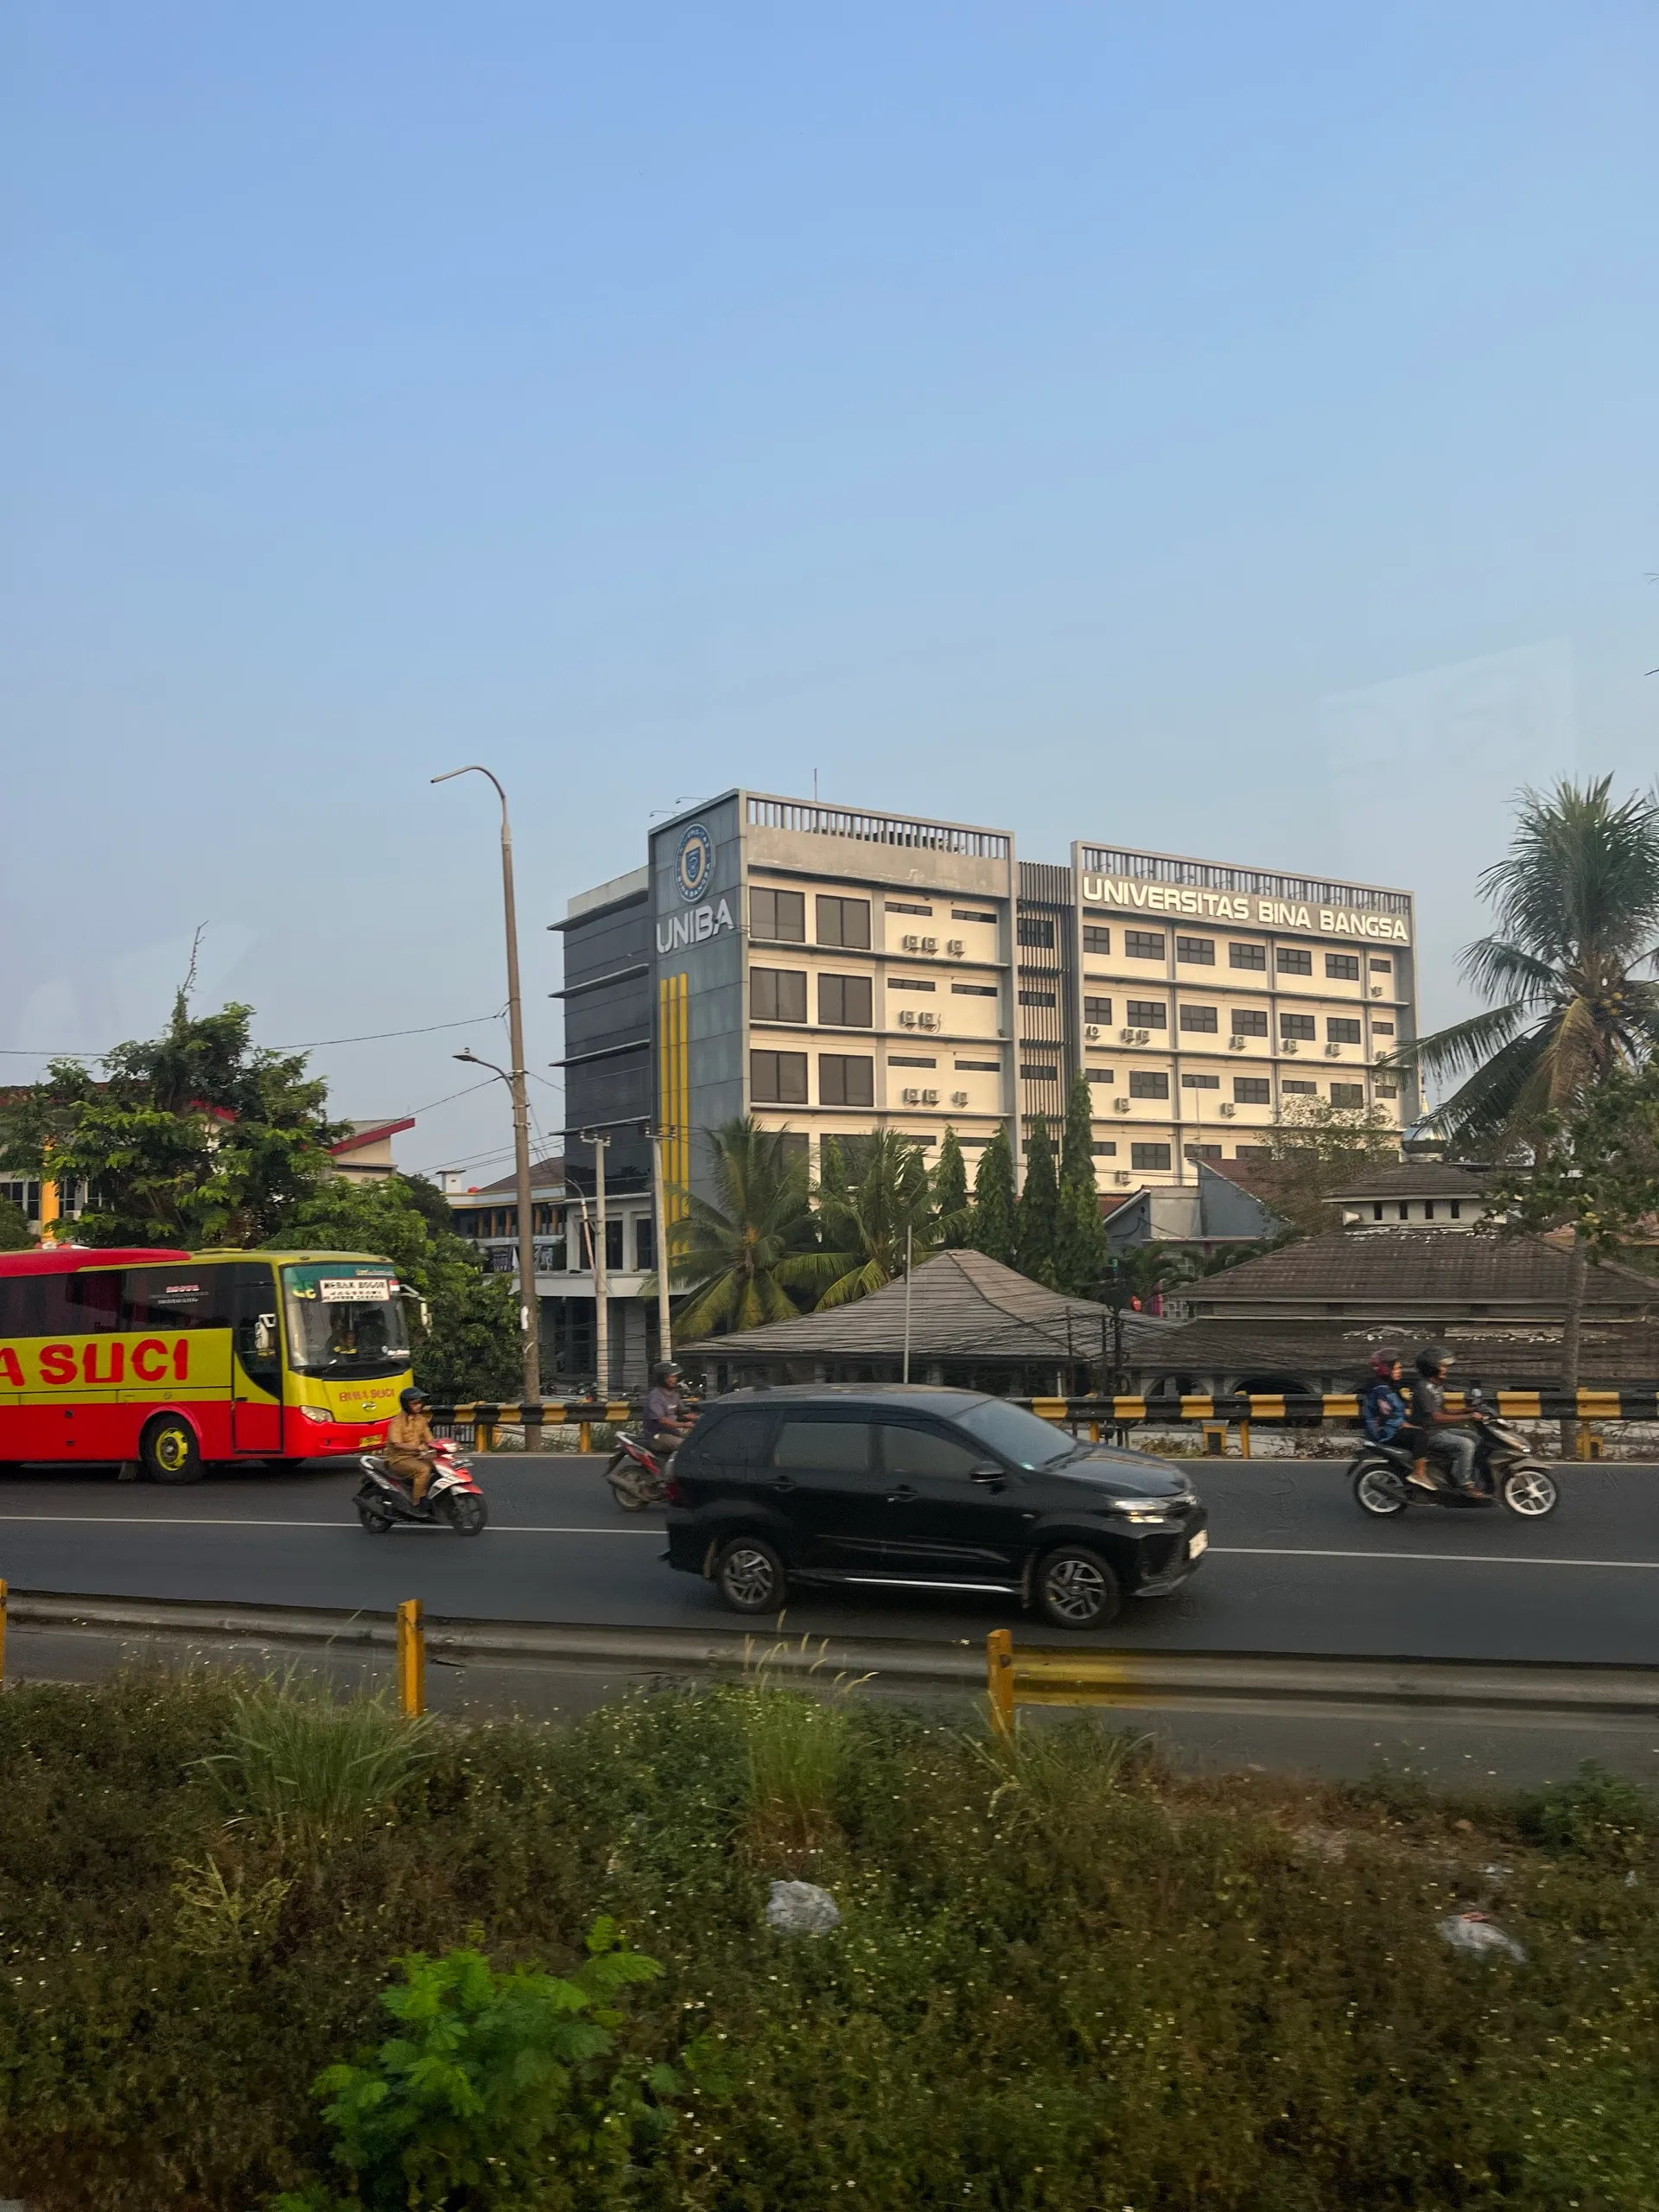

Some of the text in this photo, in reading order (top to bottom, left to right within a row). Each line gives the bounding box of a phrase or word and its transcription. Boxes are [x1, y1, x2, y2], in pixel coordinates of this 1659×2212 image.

[656, 898, 735, 954] UNIBA
[1083, 876, 1409, 941] UNIVERSITAS BINA BANGSA
[39, 1338, 188, 1384] SUCI
